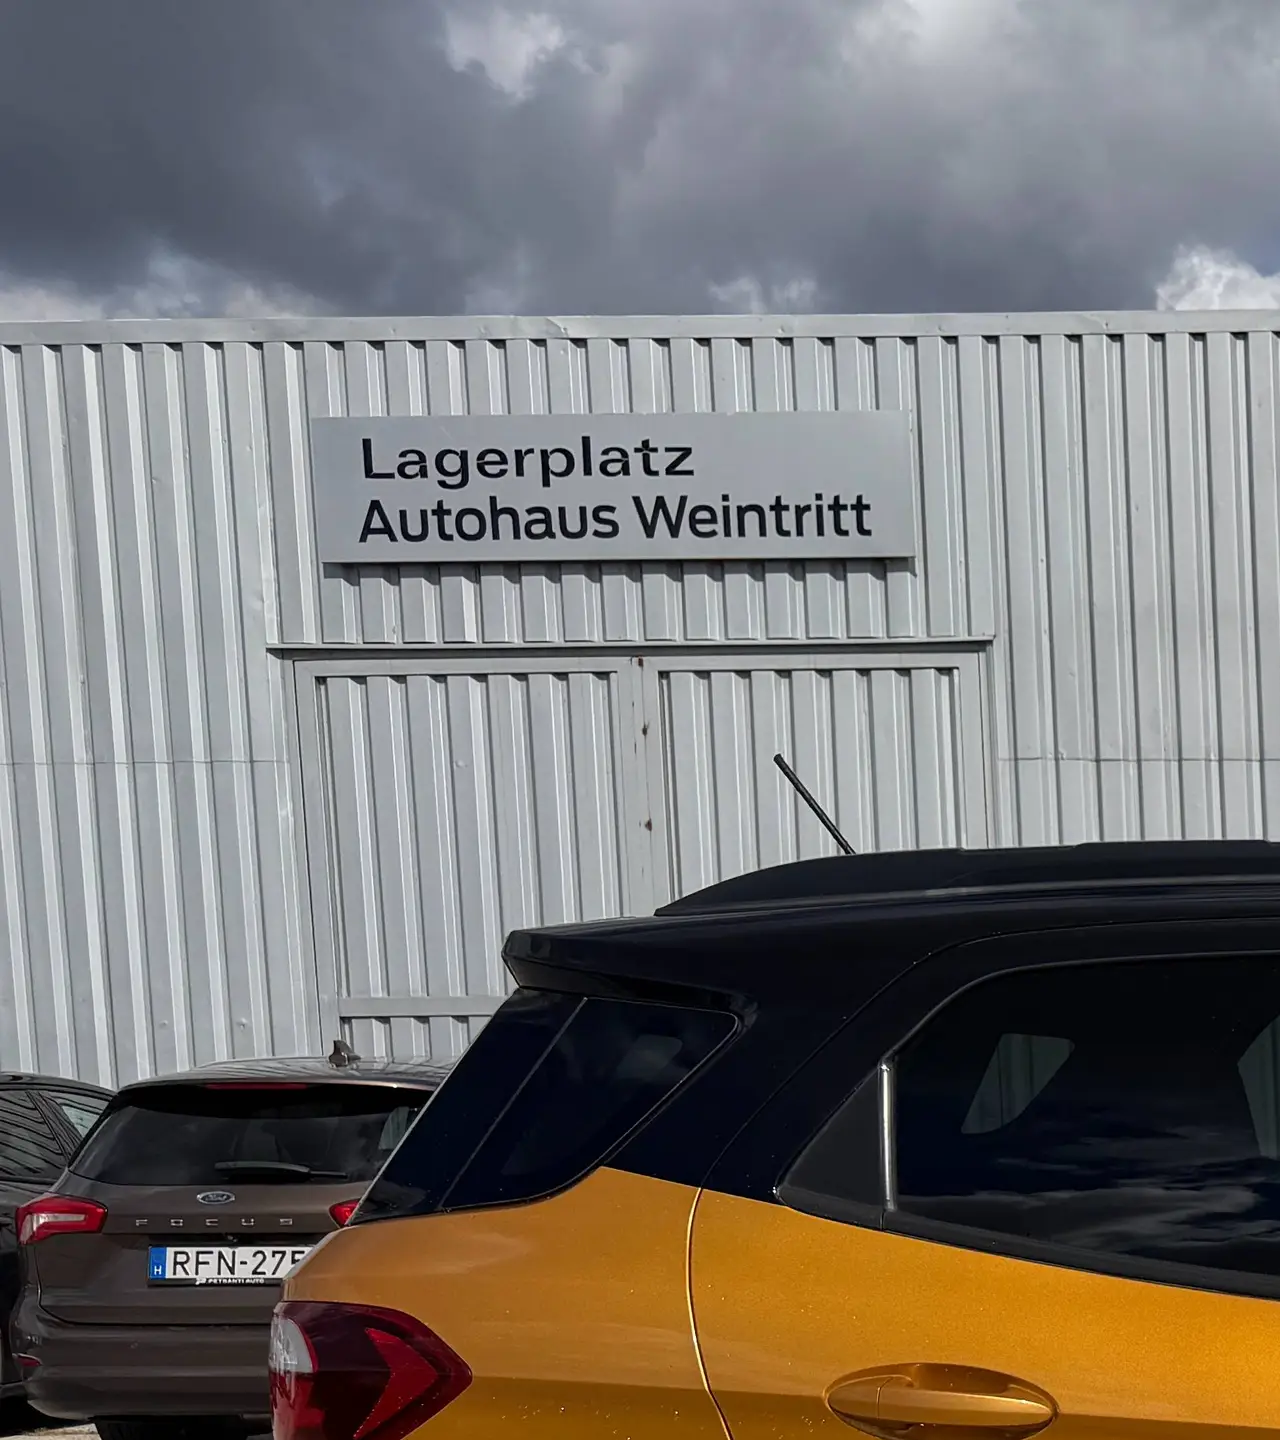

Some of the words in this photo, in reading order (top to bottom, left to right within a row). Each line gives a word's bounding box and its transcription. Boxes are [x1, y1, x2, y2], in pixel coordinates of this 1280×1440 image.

[361, 435, 695, 490] Lagerplatz
[358, 495, 620, 543] Autohaus
[631, 492, 872, 539] Weintritt
[135, 1218, 293, 1226] FOCUS
